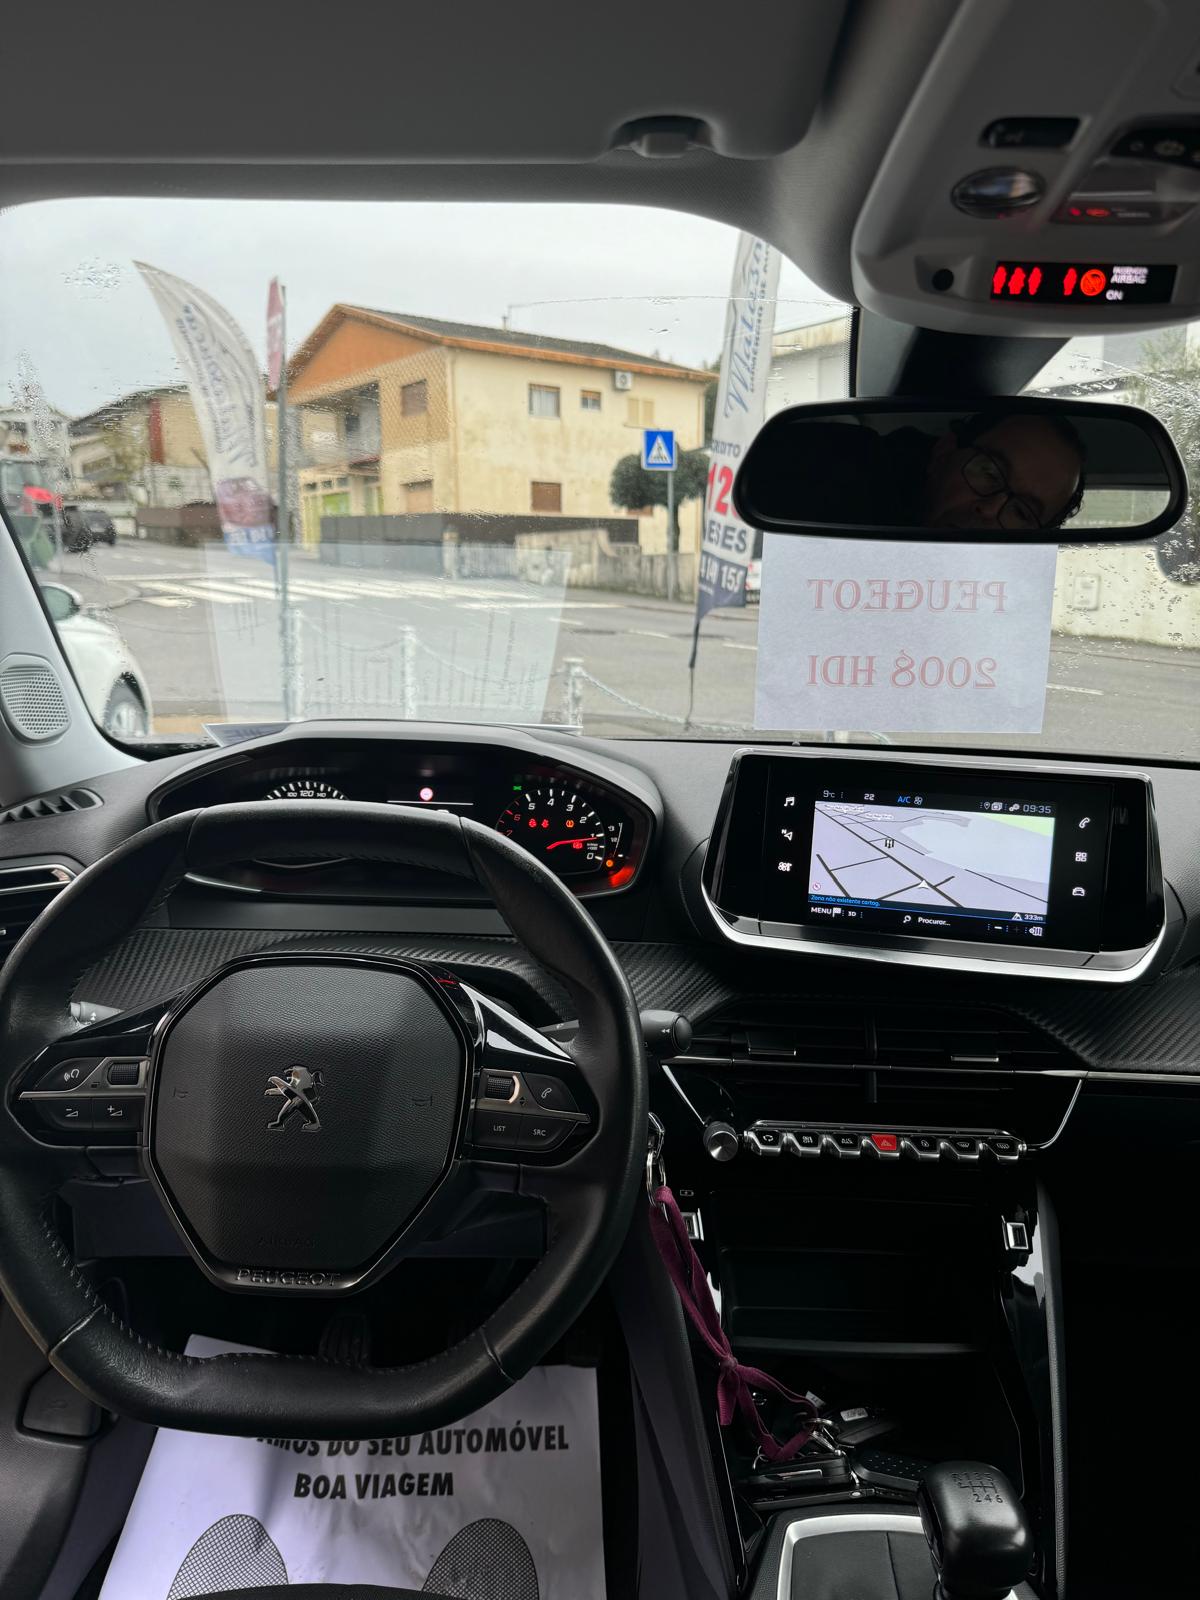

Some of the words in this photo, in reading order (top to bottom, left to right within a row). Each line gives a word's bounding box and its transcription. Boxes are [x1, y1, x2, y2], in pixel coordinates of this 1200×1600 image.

[1110, 274, 1147, 284] AIRBAG
[1105, 289, 1123, 301] ON
[707, 462, 741, 521] 12
[299, 789, 315, 798] 120
[528, 802, 536, 811] 5
[546, 798, 555, 807] 4
[863, 793, 876, 801] 22
[897, 796, 911, 804] A/C
[1022, 804, 1052, 814] 09:35
[565, 804, 574, 812] 3
[579, 816, 588, 824] 2
[586, 852, 594, 860] 0
[837, 897, 861, 905] existente
[810, 906, 832, 915] MENU
[493, 1125, 506, 1133] LIST
[532, 1128, 547, 1137] SRC
[235, 1267, 341, 1287] PEUGEOT
[327, 1440, 360, 1457] DO
[367, 1437, 411, 1456] SEU
[418, 1420, 569, 1456] AUTOMÓVEL
[294, 1473, 347, 1500] BOA
[355, 1472, 454, 1500] VIAGEM
[973, 1493, 982, 1503] 2
[995, 1494, 1004, 1504] 6
